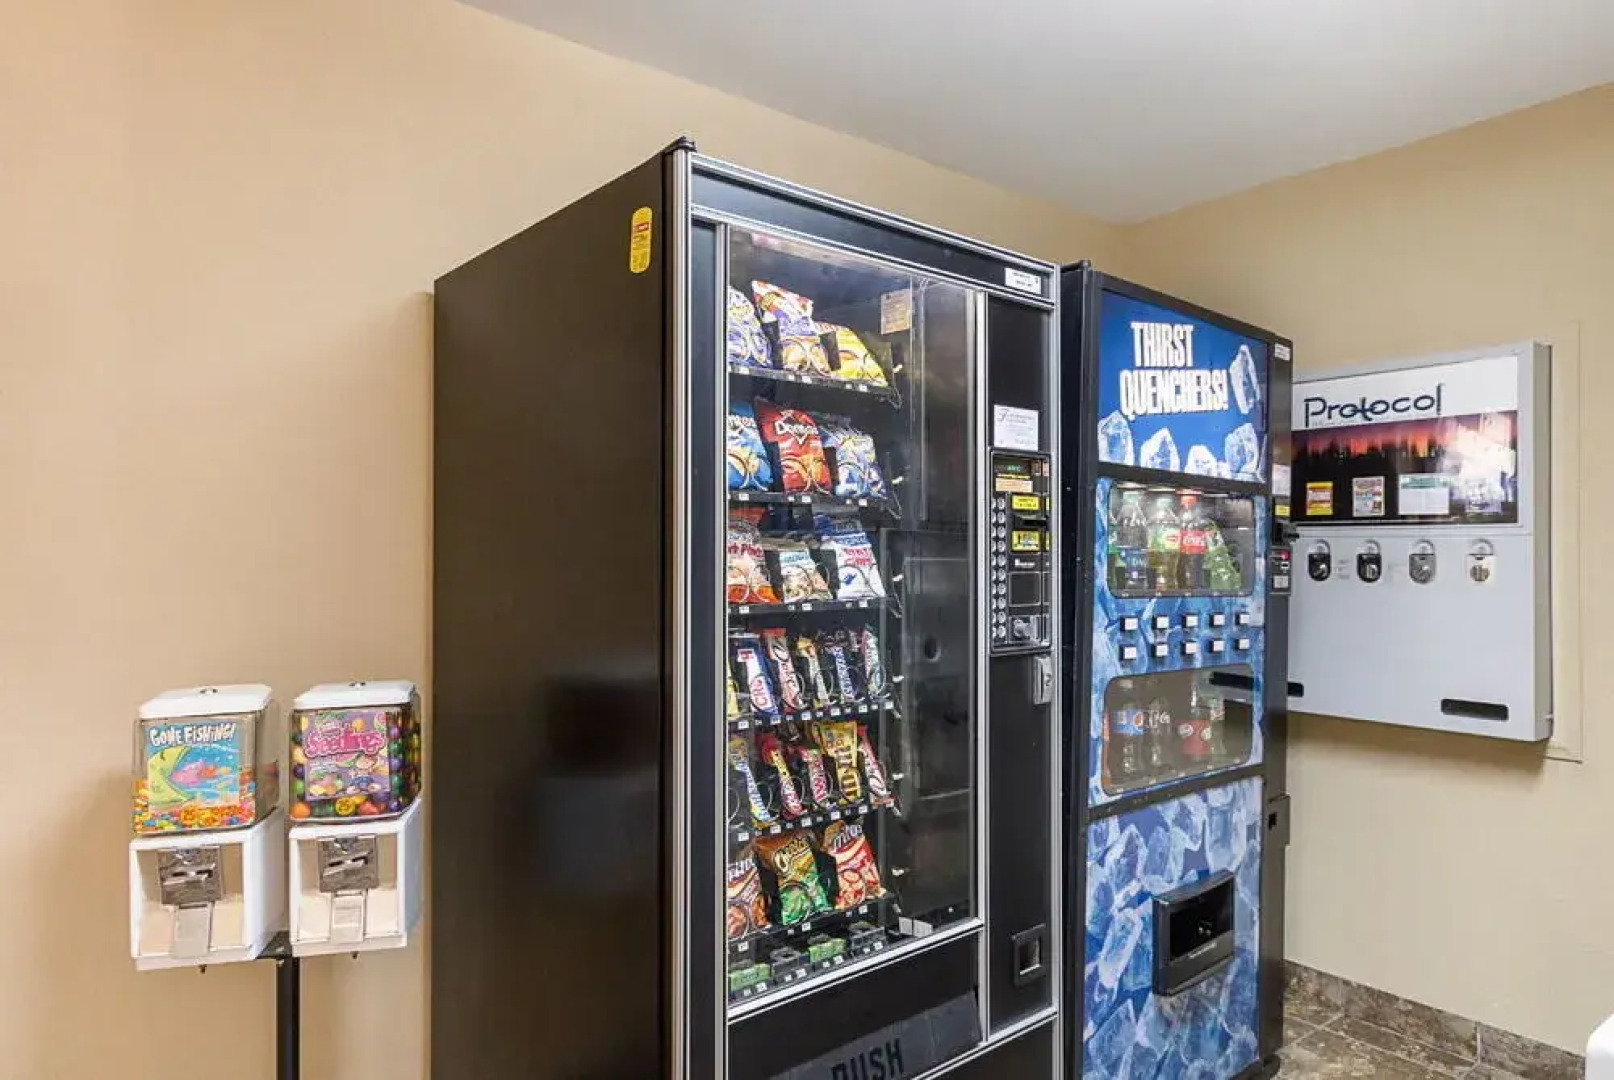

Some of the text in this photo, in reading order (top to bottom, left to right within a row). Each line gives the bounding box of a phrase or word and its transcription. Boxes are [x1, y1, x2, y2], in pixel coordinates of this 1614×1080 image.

[1131, 321, 1194, 367] THIRST
[1119, 369, 1229, 421] QUENCHERS!
[1303, 382, 1444, 428] Protocol
[774, 420, 818, 444] Doritos
[150, 726, 182, 747] GONE
